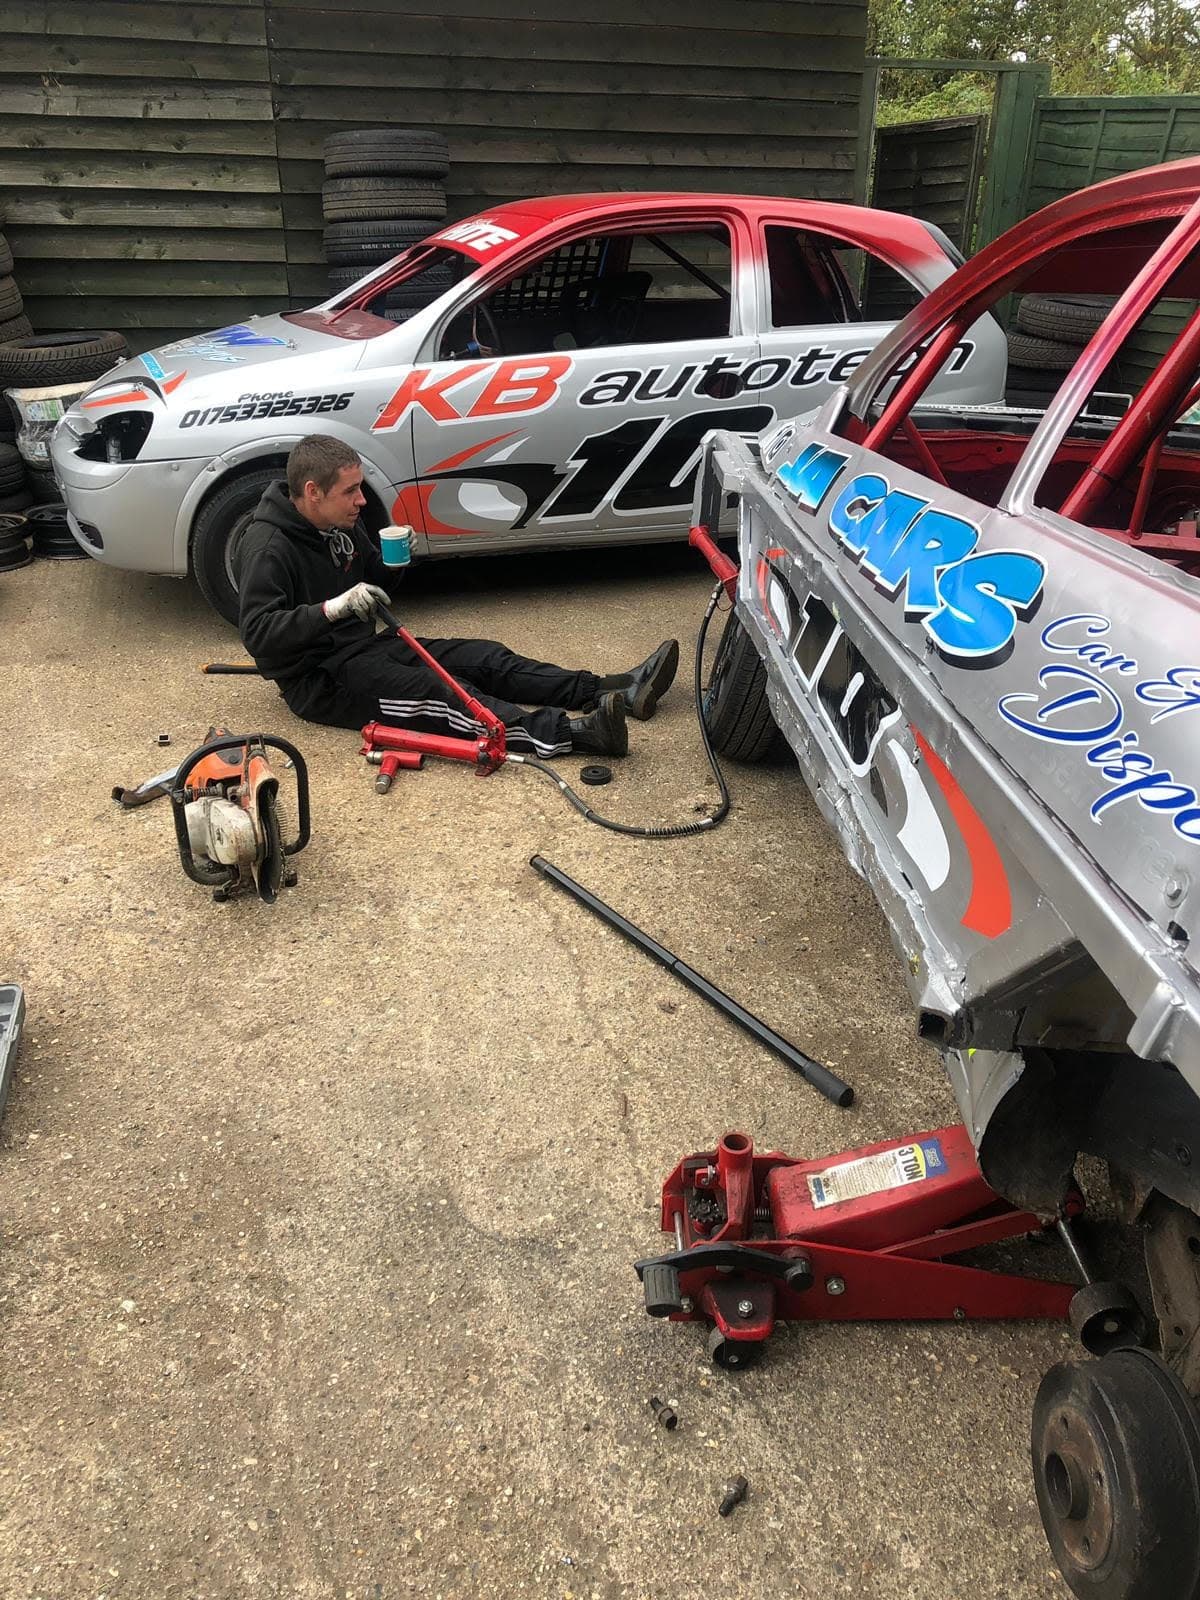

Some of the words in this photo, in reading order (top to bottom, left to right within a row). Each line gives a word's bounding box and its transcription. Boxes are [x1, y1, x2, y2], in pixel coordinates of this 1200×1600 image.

[435, 222, 521, 252] HITE
[179, 392, 355, 429] 01753325326
[237, 390, 295, 404] Phone
[370, 355, 573, 434] KB
[776, 441, 852, 512] JA
[828, 474, 1049, 657] CARS
[1040, 613, 1139, 678] Car
[898, 1146, 916, 1157] 3
[902, 1156, 925, 1182] TON
